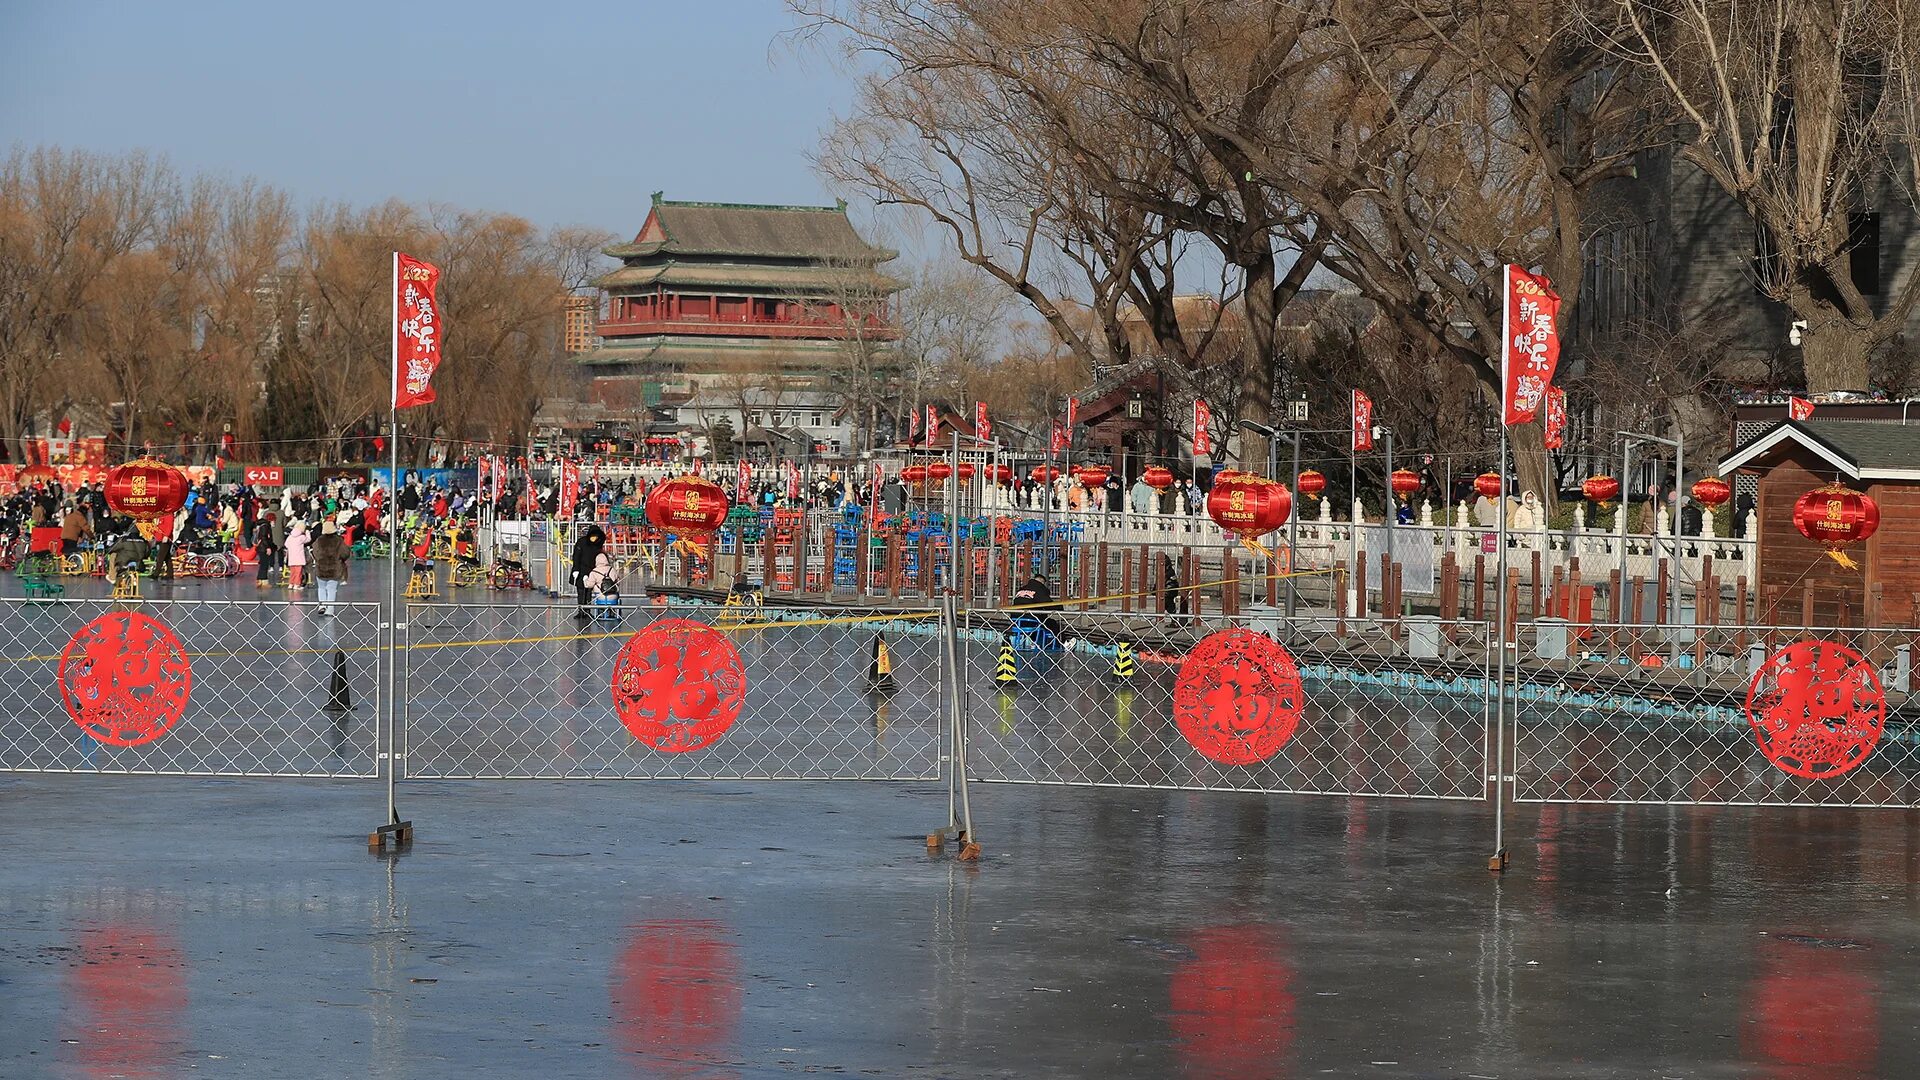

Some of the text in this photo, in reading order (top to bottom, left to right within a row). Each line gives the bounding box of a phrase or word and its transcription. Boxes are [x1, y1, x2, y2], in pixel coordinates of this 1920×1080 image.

[402, 283, 436, 354] 新春快乐
[1514, 297, 1554, 371] 新春快乐
[258, 470, 279, 481] 入口
